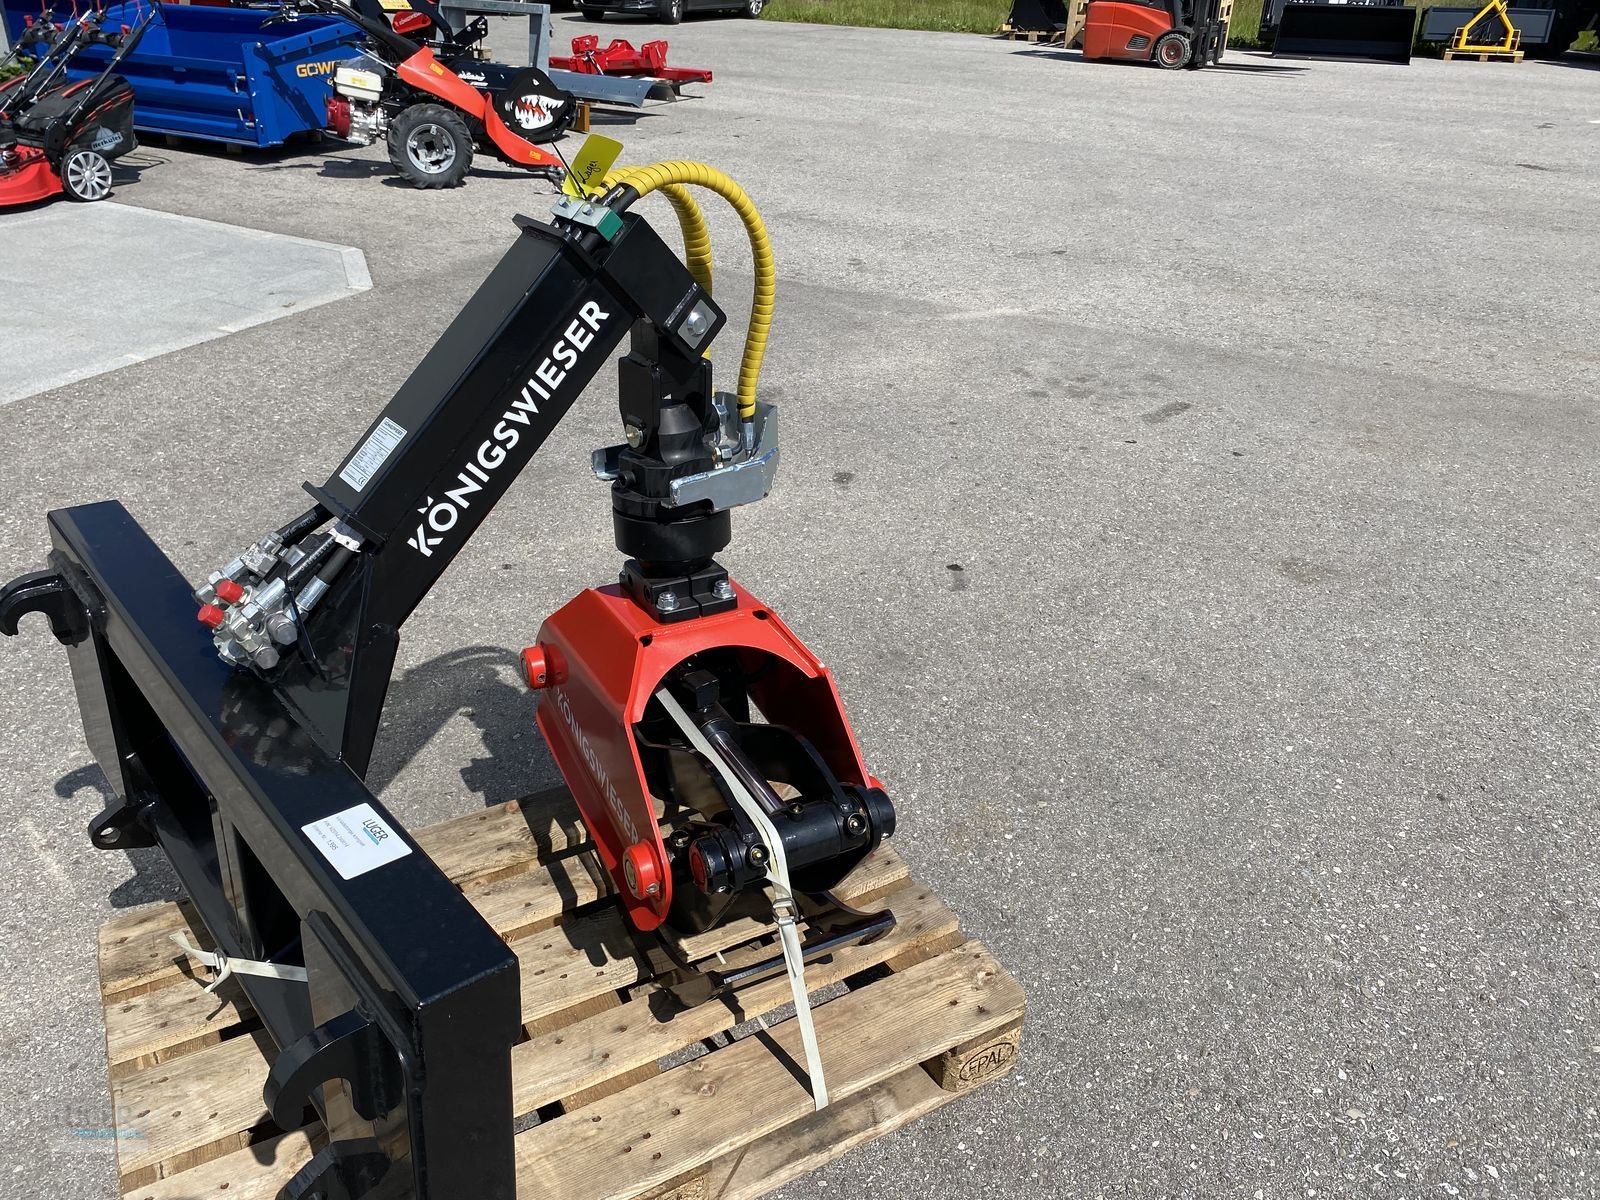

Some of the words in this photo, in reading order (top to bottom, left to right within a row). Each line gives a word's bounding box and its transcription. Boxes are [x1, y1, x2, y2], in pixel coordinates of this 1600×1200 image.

[407, 301, 610, 557] KÖNIGSWIESER
[362, 818, 389, 842] LUGER
[557, 687, 639, 844] KÖNIGSWIESER
